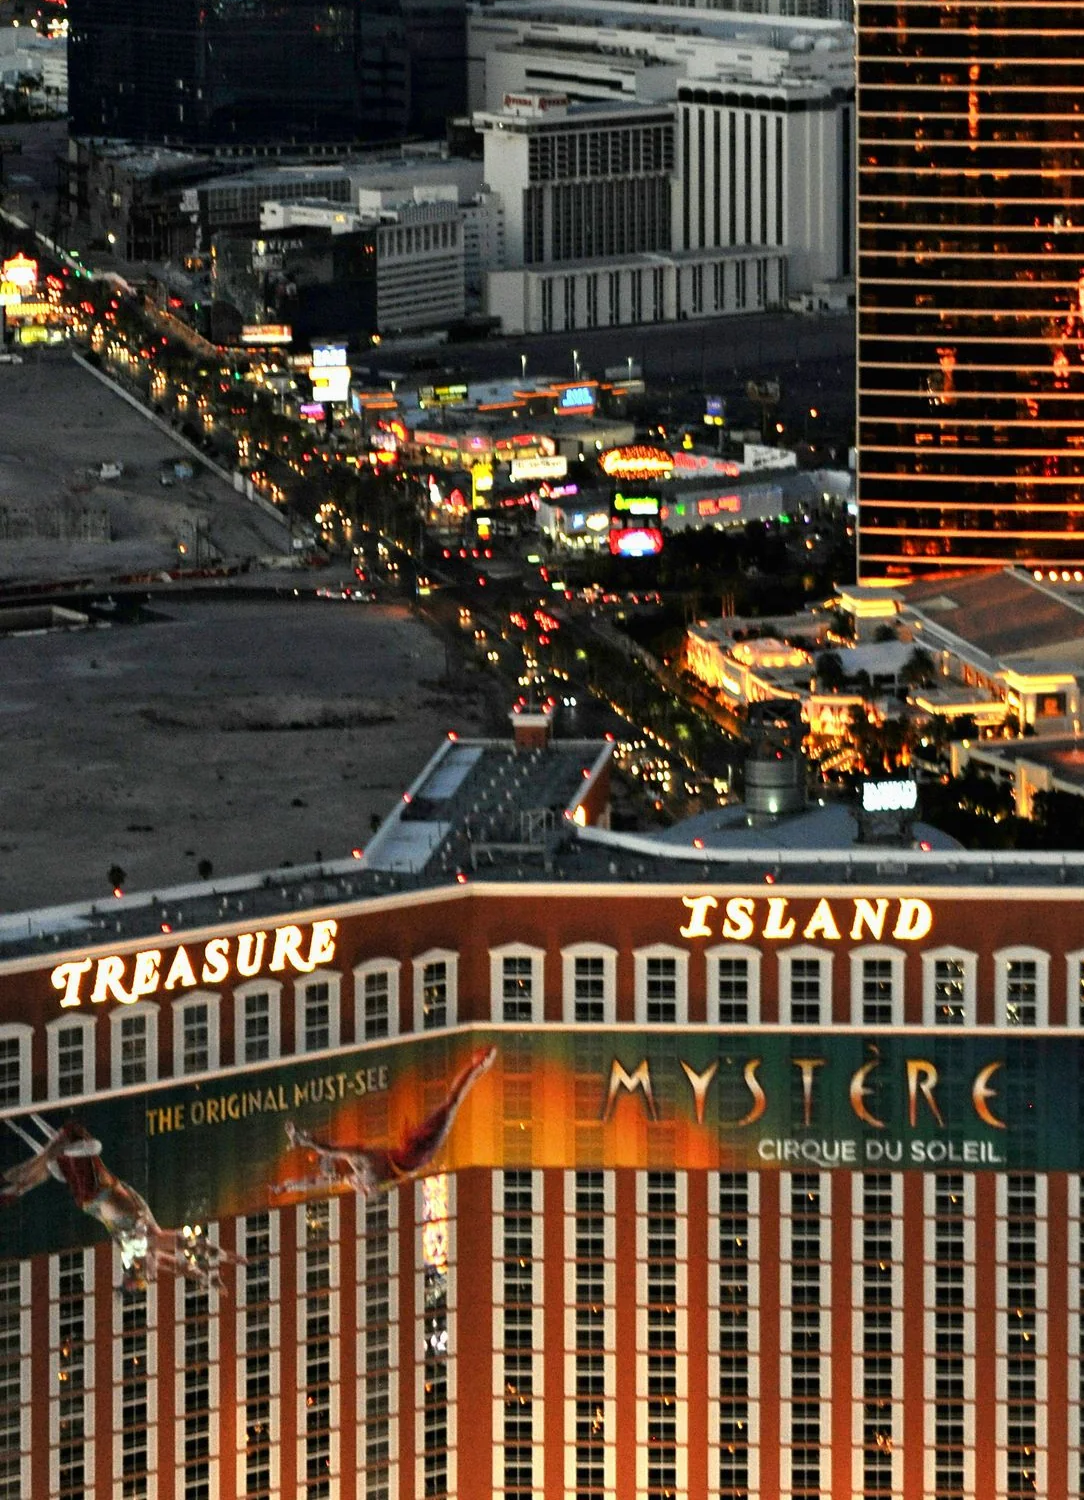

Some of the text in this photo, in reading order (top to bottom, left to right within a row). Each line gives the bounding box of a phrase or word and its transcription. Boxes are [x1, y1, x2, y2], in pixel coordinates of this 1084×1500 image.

[680, 895, 933, 940] ISLAND
[51, 919, 338, 1007] TREASURE
[146, 1065, 389, 1136] THE ORIGINAL MUST-SEE
[603, 1043, 1007, 1129] MYSTÈRE
[757, 1138, 1001, 1166] CIRQUE DU SOLEIL
